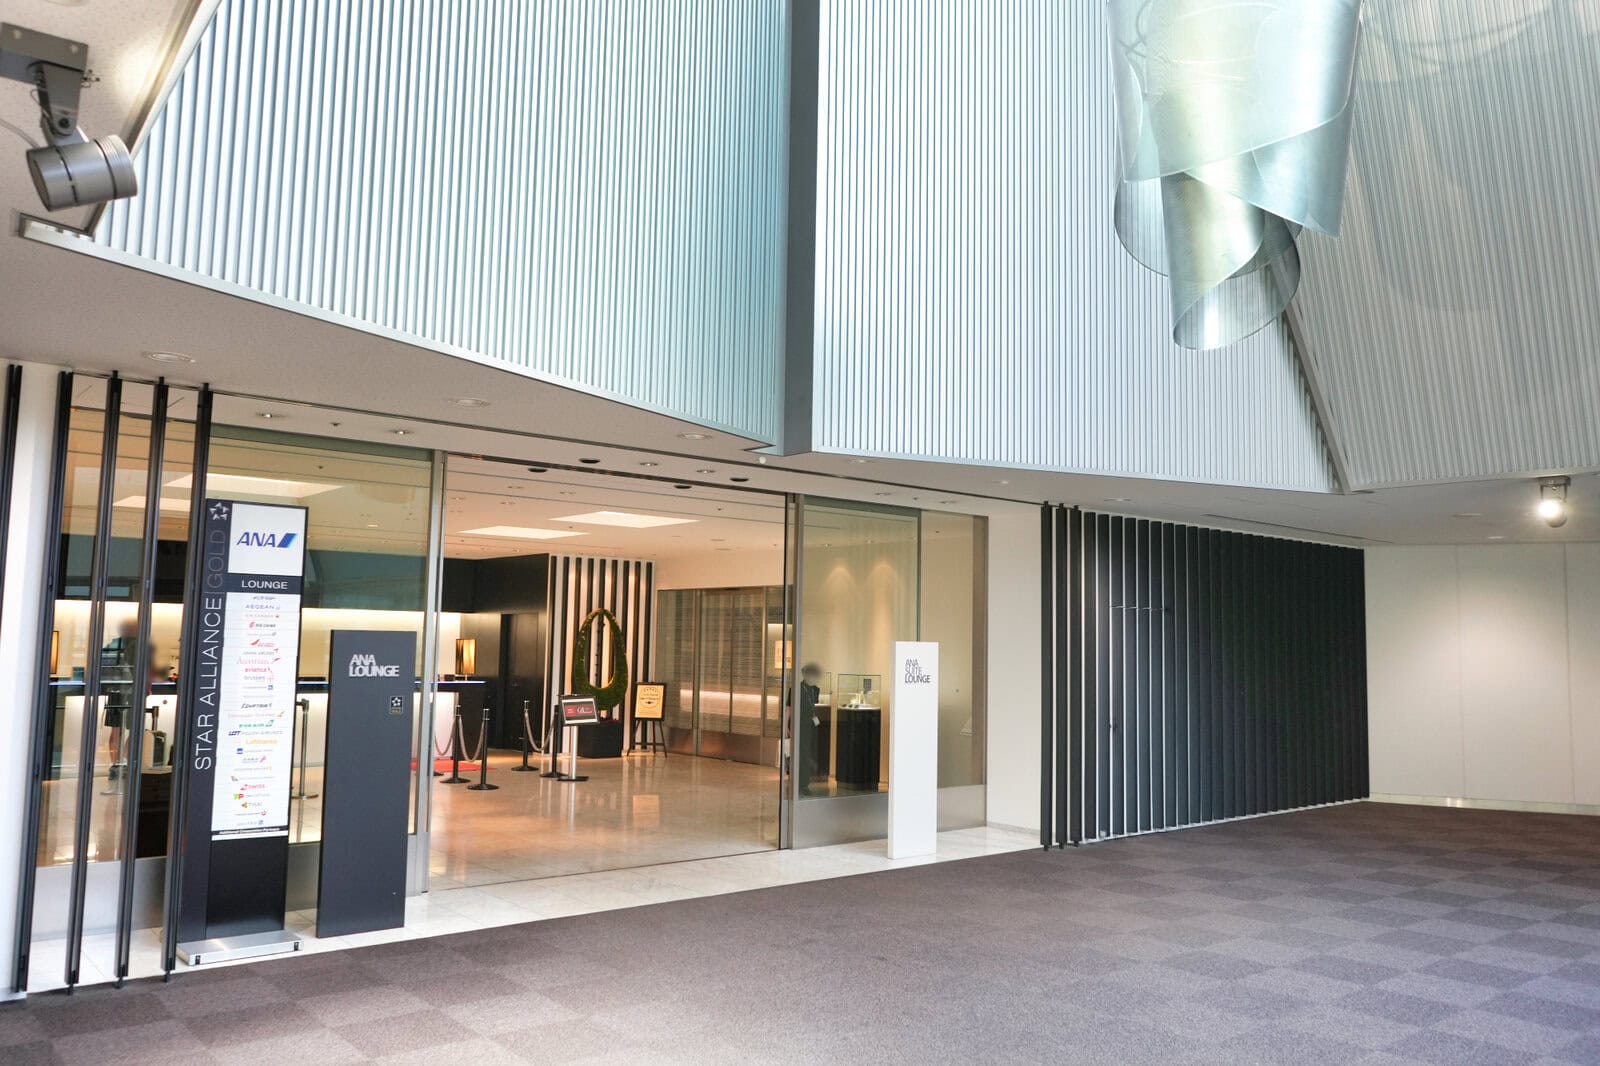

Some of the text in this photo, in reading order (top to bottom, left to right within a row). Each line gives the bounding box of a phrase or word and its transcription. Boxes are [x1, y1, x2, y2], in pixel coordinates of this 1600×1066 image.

[236, 531, 277, 548] ANA
[241, 579, 289, 590] LOUNGE
[195, 529, 226, 770] STAR ALLIANCE GOLD
[349, 654, 377, 666] ANA
[905, 658, 919, 667] ANA
[348, 665, 400, 678] LOUNGE
[904, 674, 931, 684] LOUNGE
